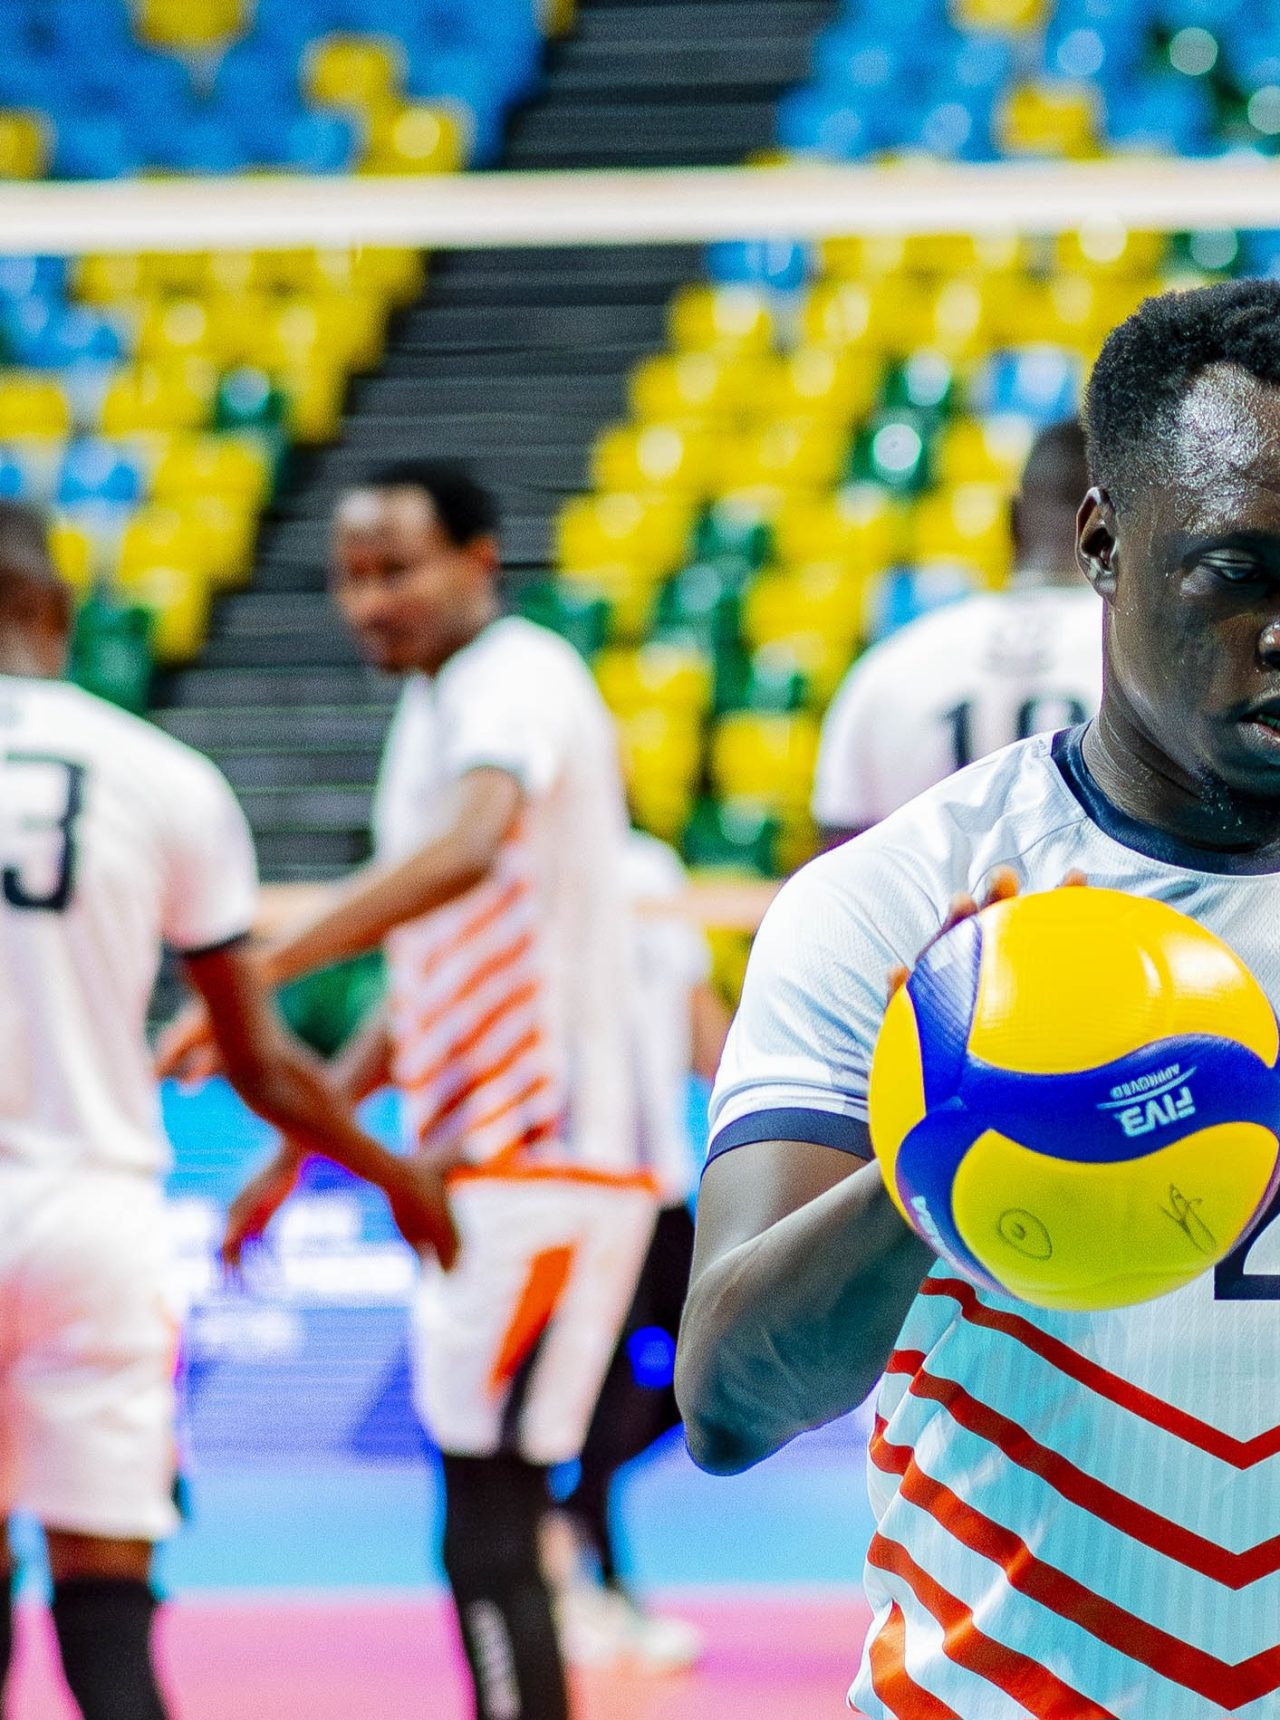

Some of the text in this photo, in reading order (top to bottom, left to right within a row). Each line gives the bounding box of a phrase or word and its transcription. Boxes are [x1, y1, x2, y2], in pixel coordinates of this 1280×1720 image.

[3, 753, 88, 910] 3
[1110, 1063, 1180, 1099] APPROVED
[1120, 1086, 1196, 1137] FIVB
